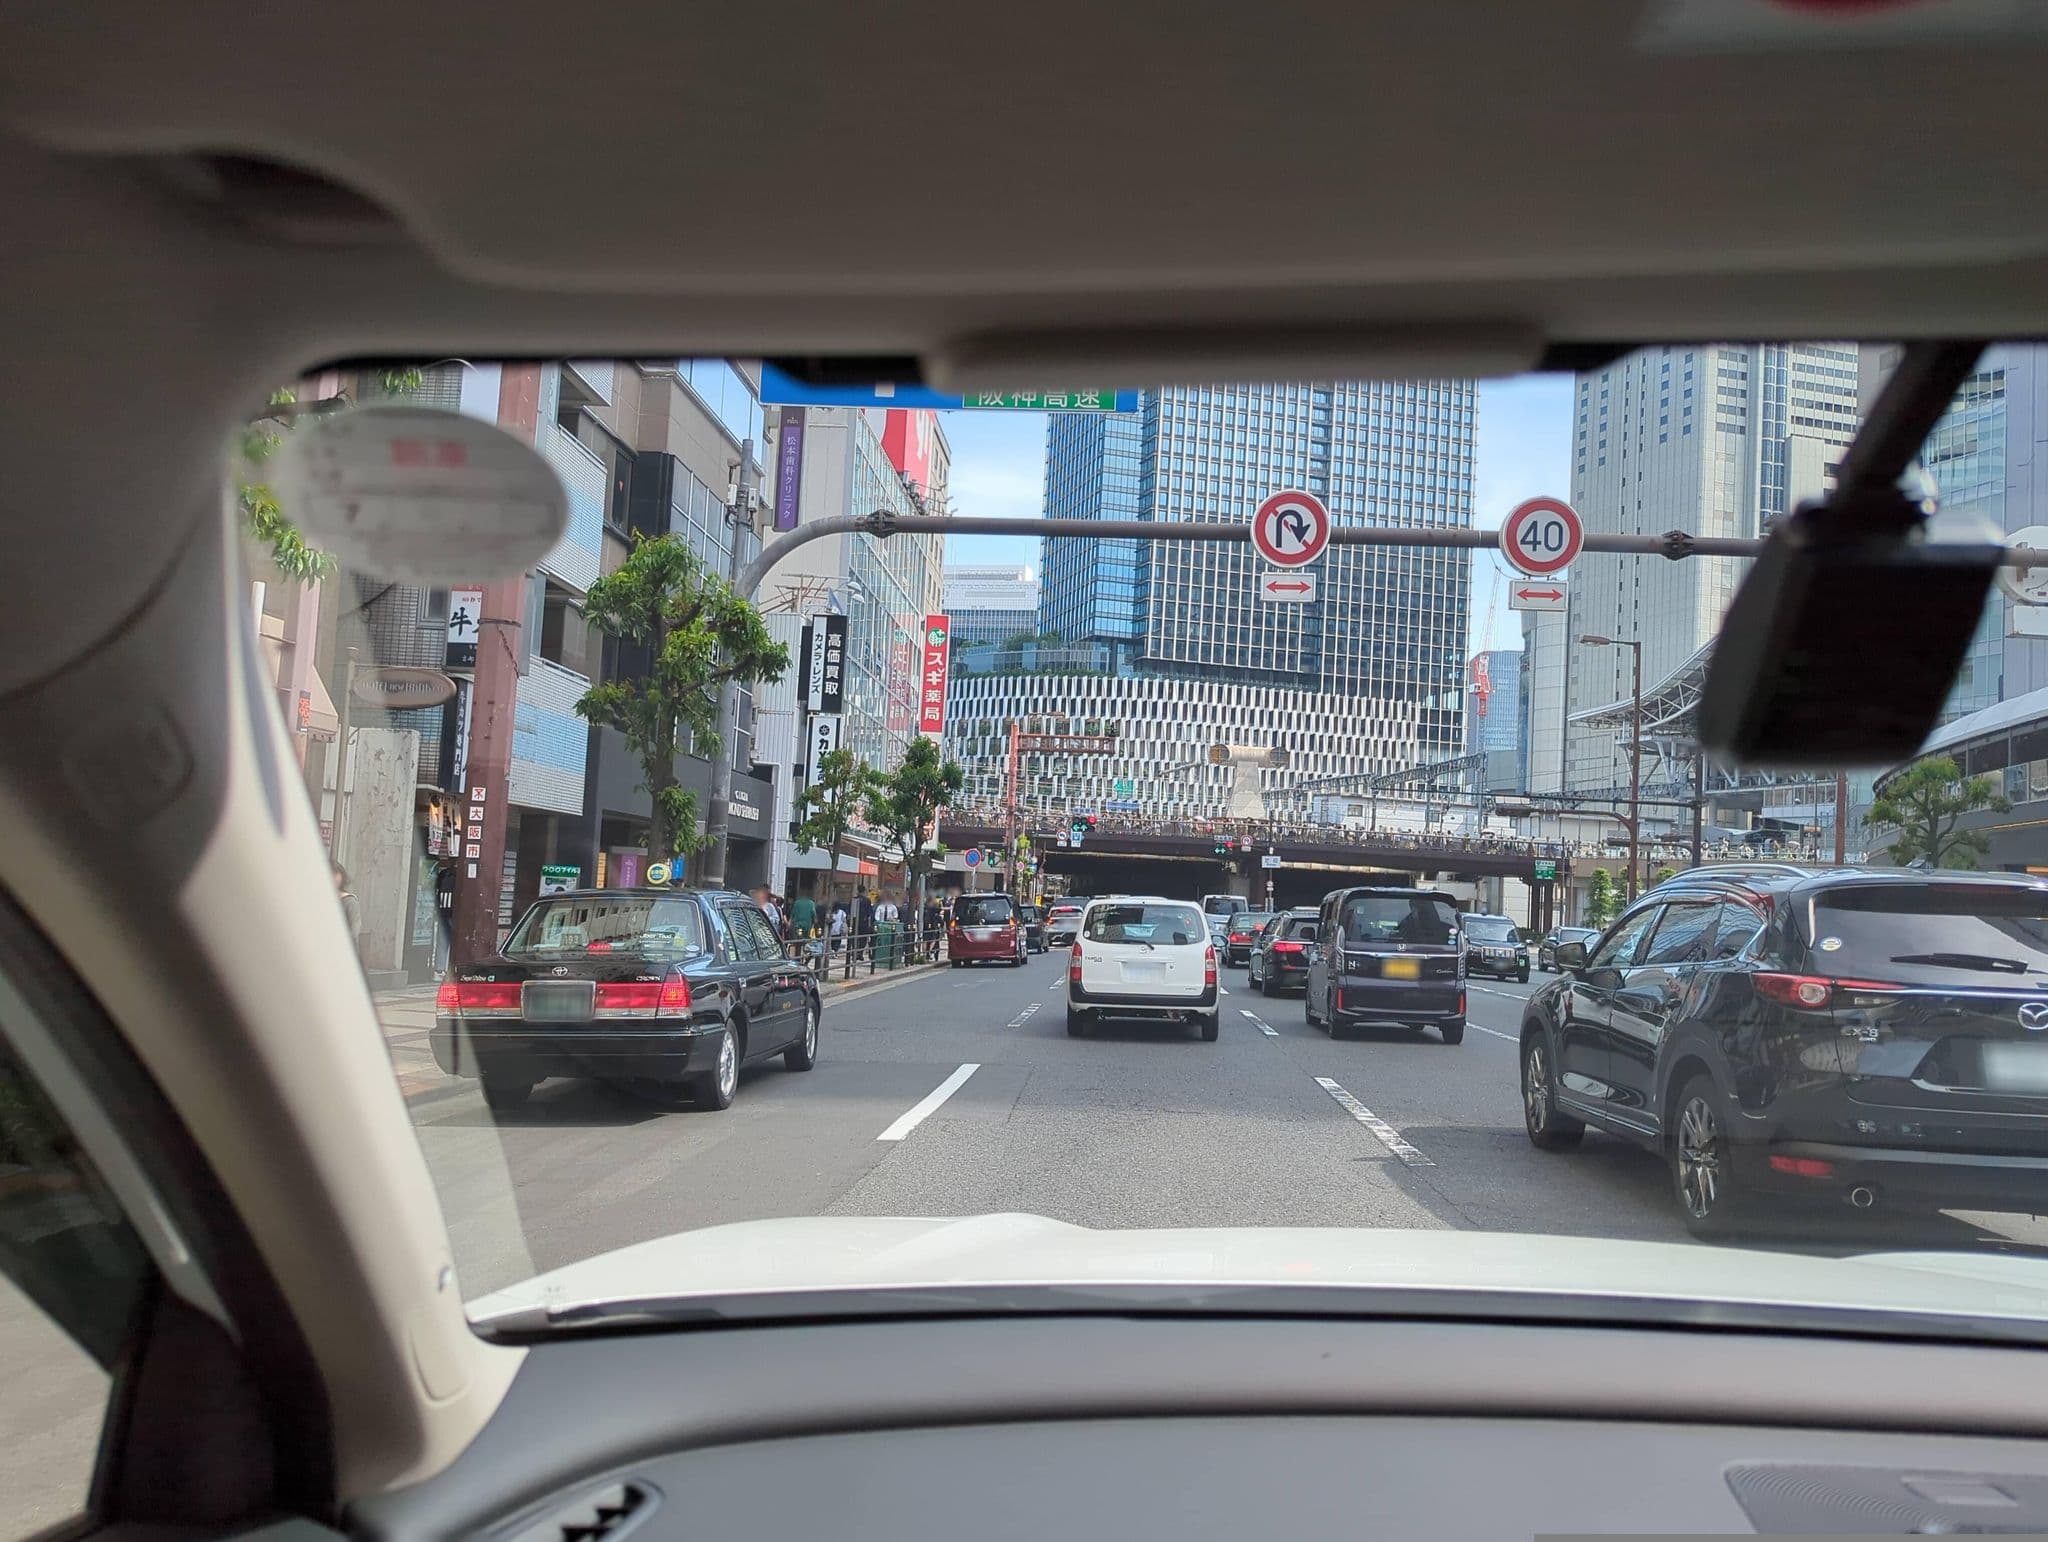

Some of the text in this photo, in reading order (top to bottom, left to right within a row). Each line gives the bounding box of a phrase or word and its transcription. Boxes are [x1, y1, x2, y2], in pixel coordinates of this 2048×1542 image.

[978, 388, 1100, 408] 阪神高速
[783, 436, 797, 518] 松本歯科クリニック
[1520, 520, 1563, 551] 40
[811, 632, 824, 694] カメラ・レンズ
[825, 633, 842, 695] 高価買取
[924, 651, 945, 721] スギ薬局
